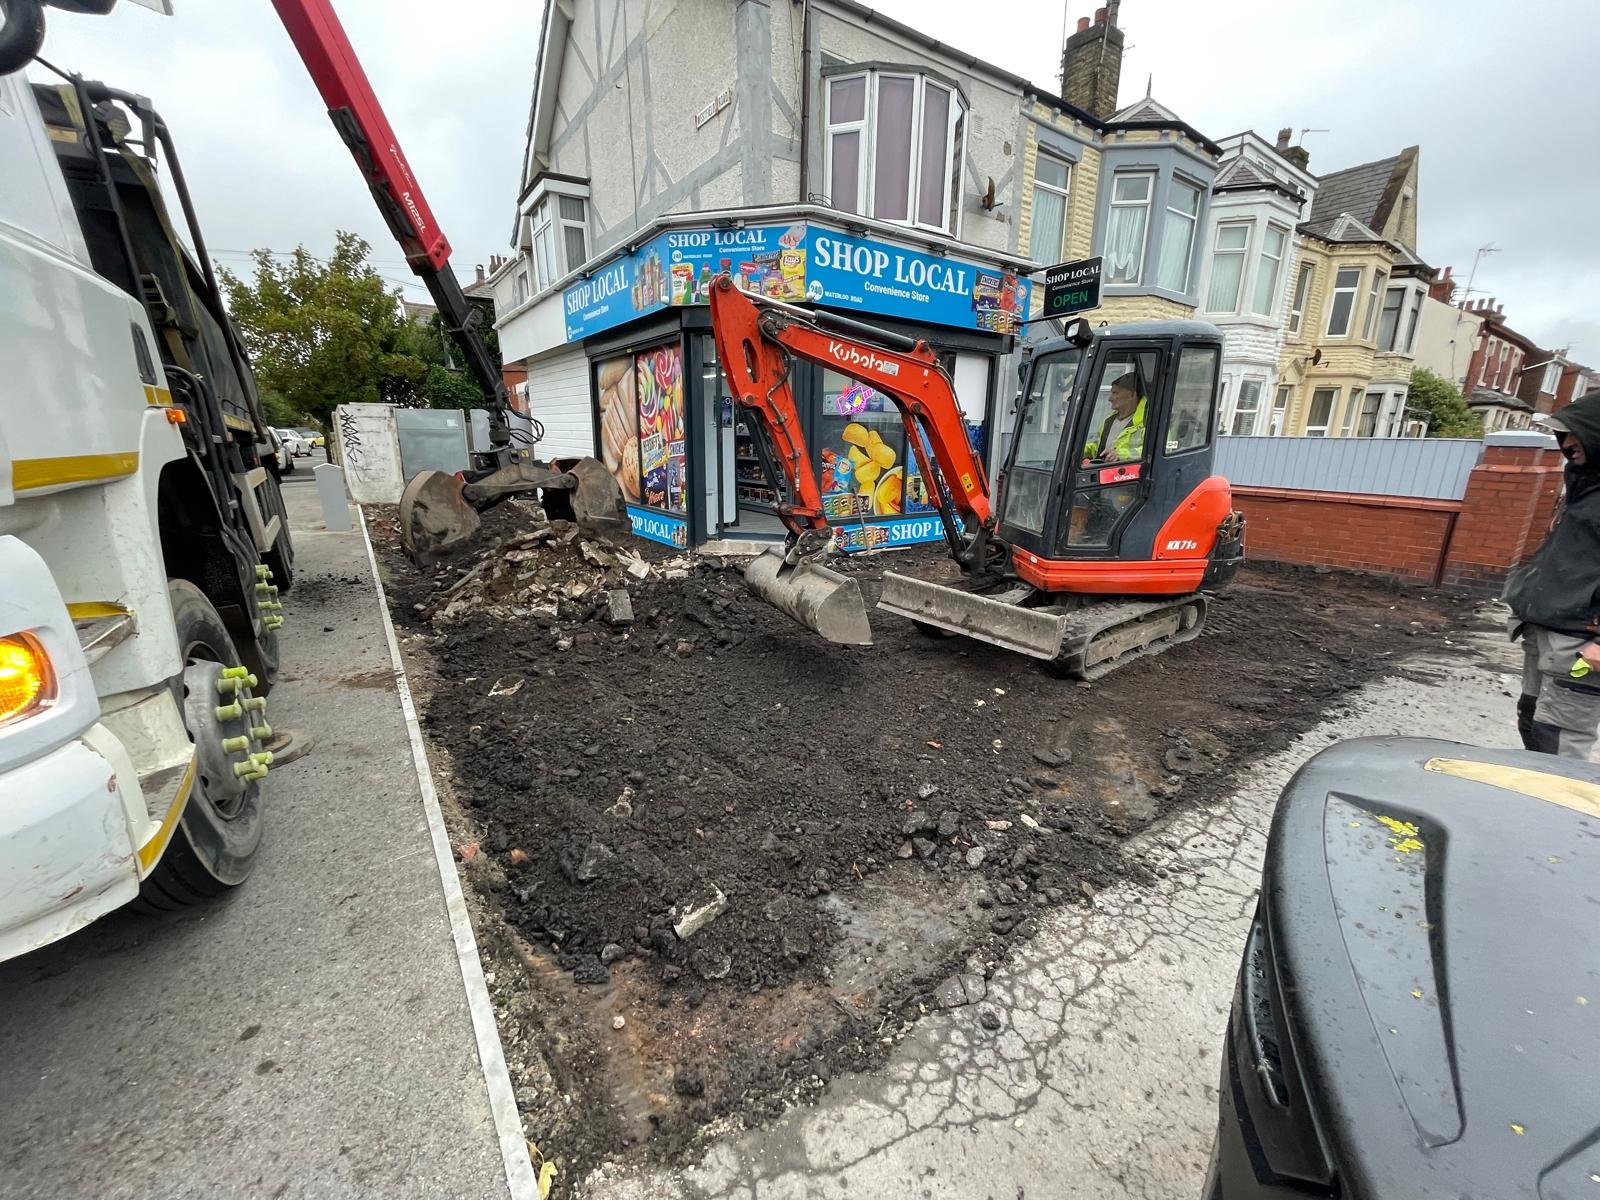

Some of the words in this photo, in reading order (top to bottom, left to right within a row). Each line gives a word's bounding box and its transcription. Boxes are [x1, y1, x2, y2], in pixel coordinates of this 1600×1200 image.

[669, 233, 711, 248] SHOP
[714, 230, 767, 246] LOCAL
[814, 236, 890, 278] SHOP
[894, 255, 969, 296] LOCAL
[1046, 272, 1070, 285] SHOP
[1070, 265, 1101, 280] LOCAL
[567, 284, 591, 315] SHOP
[592, 265, 629, 304] LOCAL
[824, 290, 850, 301] WATERLOO
[850, 295, 864, 304] ROAD
[864, 281, 910, 300] Convenience
[911, 290, 930, 303] Store
[1053, 289, 1089, 309] OPEN
[829, 341, 884, 373] Kubota
[644, 518, 671, 539] LOCAL
[891, 522, 931, 542] SHOP
